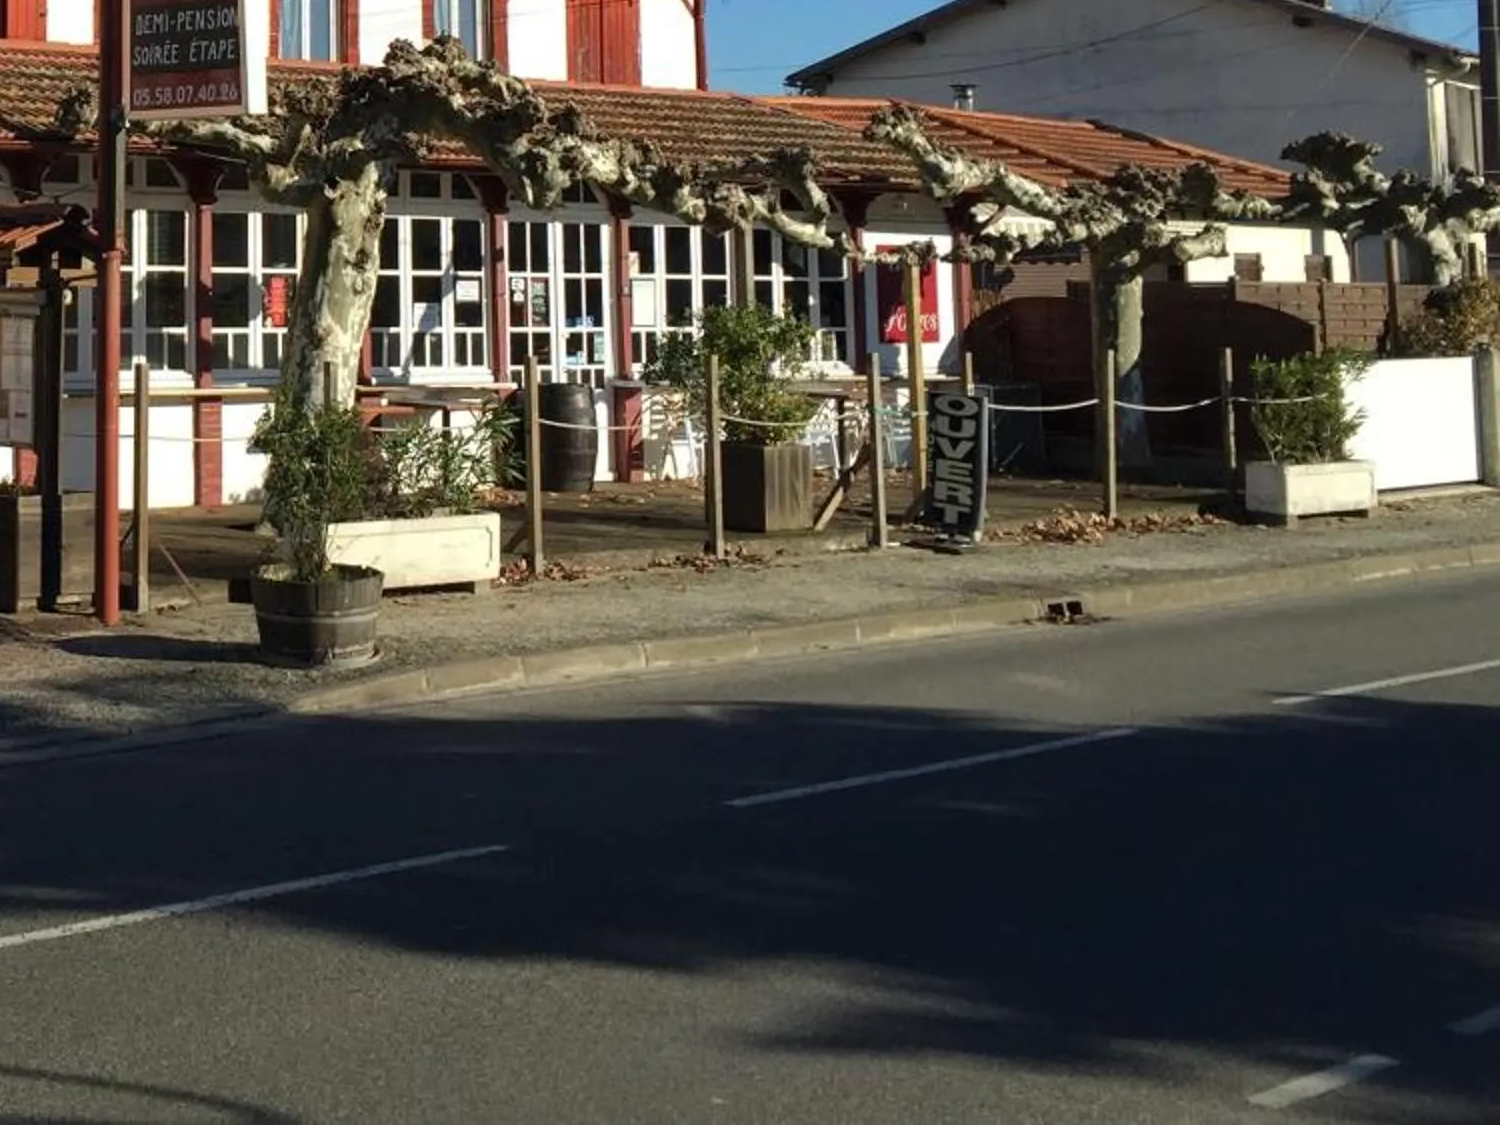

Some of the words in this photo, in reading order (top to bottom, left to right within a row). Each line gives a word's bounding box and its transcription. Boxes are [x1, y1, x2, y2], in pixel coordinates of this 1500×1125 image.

[133, 39, 180, 66] SOIRÉE
[189, 37, 237, 62] ÉTAPE
[932, 394, 980, 524] OUVERT
